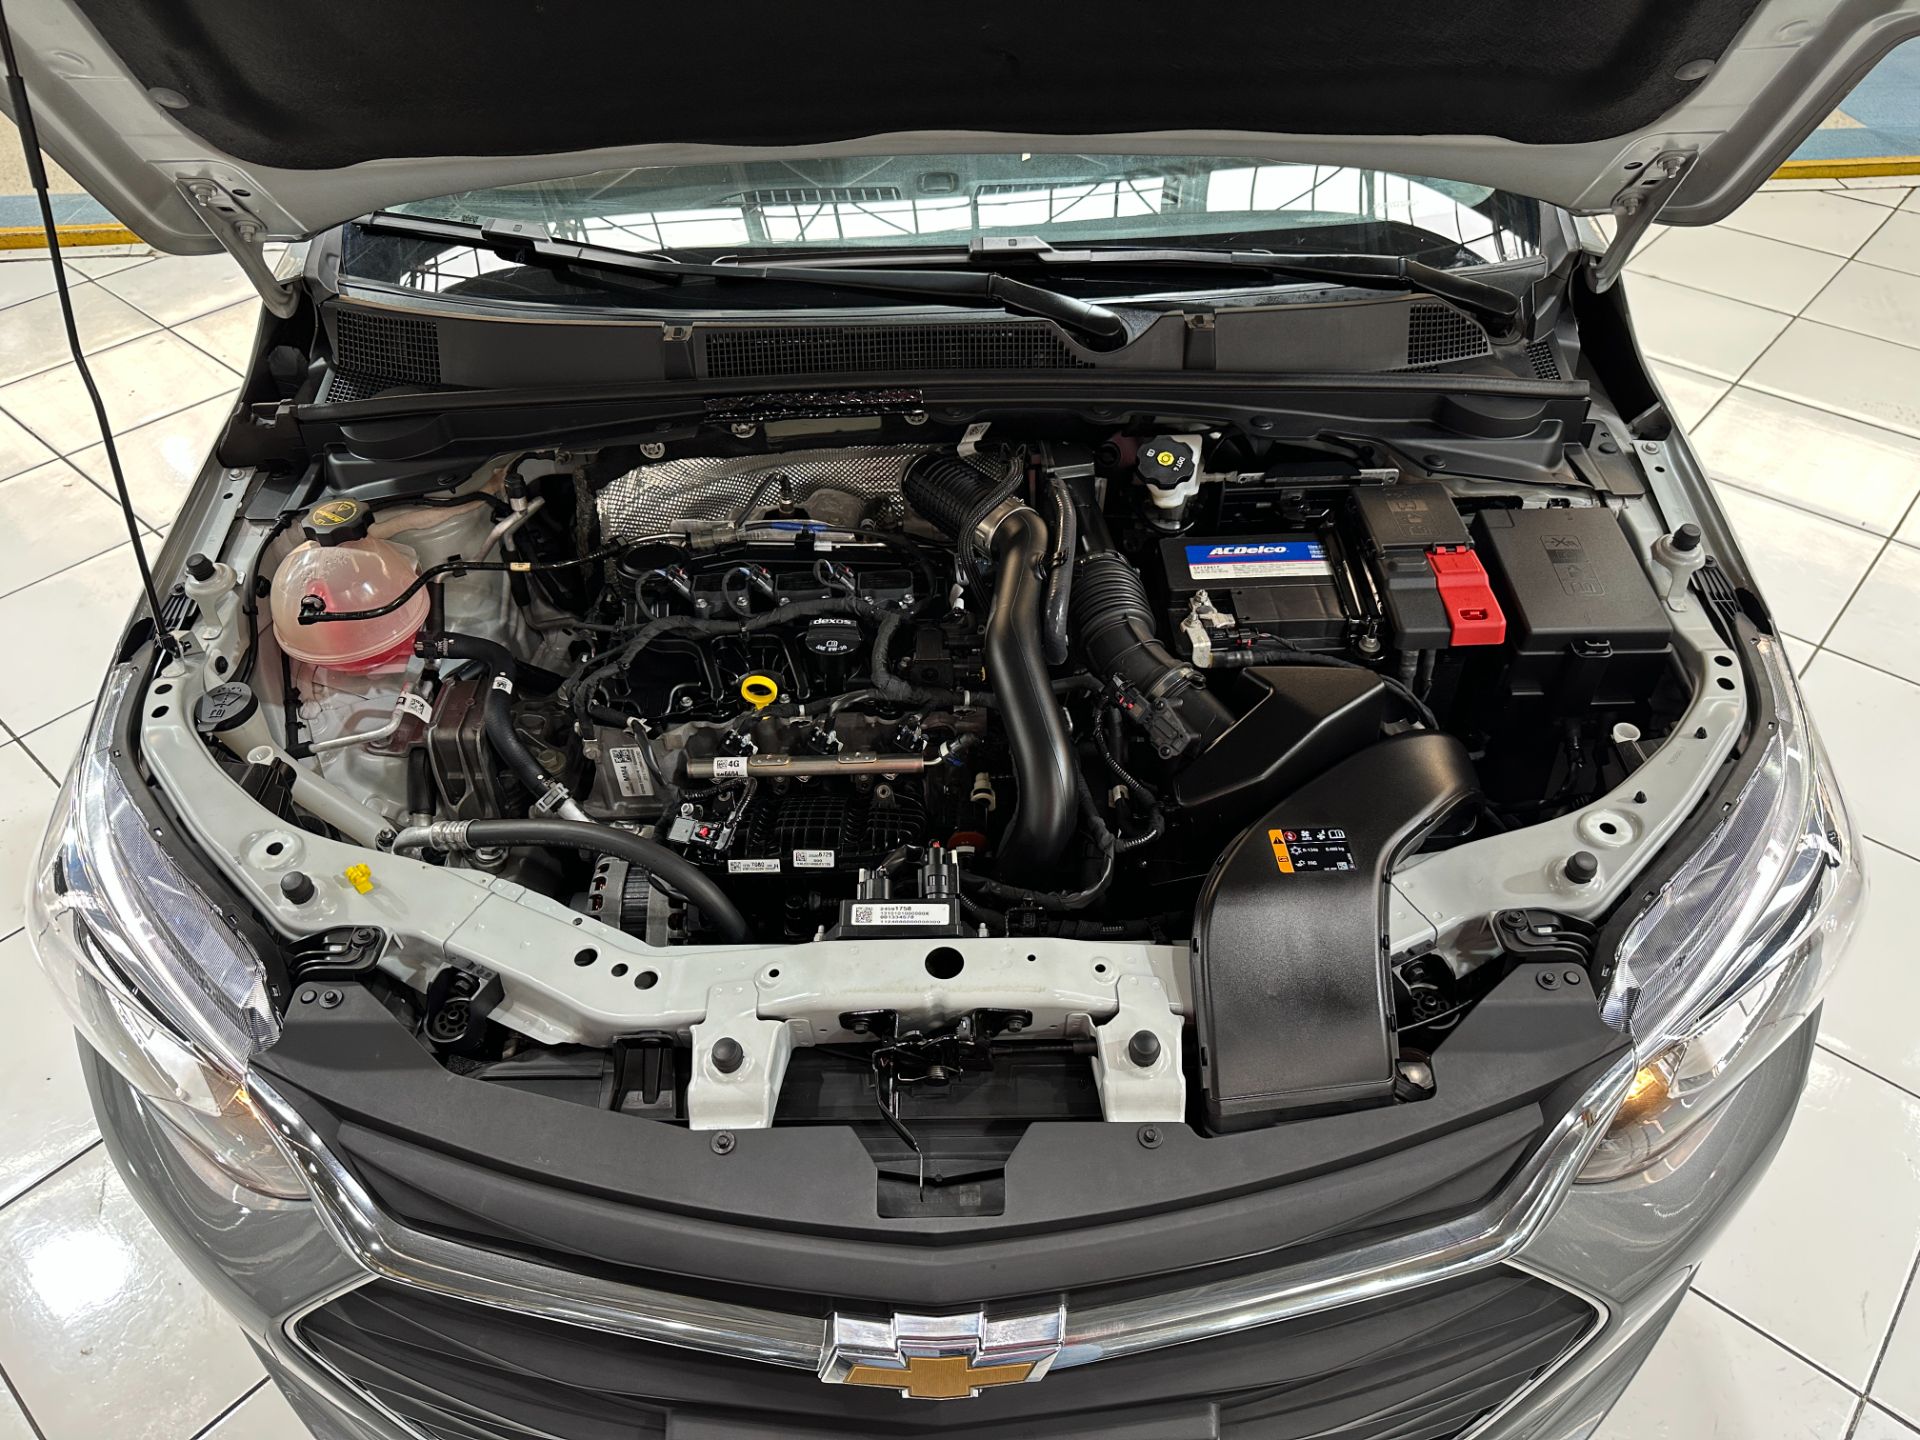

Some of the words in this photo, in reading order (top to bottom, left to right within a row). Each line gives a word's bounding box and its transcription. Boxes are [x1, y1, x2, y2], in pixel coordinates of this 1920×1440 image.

[1176, 456, 1186, 468] DOT
[1209, 545, 1287, 555] ACDelco
[813, 617, 851, 625] dexos
[728, 760, 740, 768] 4G
